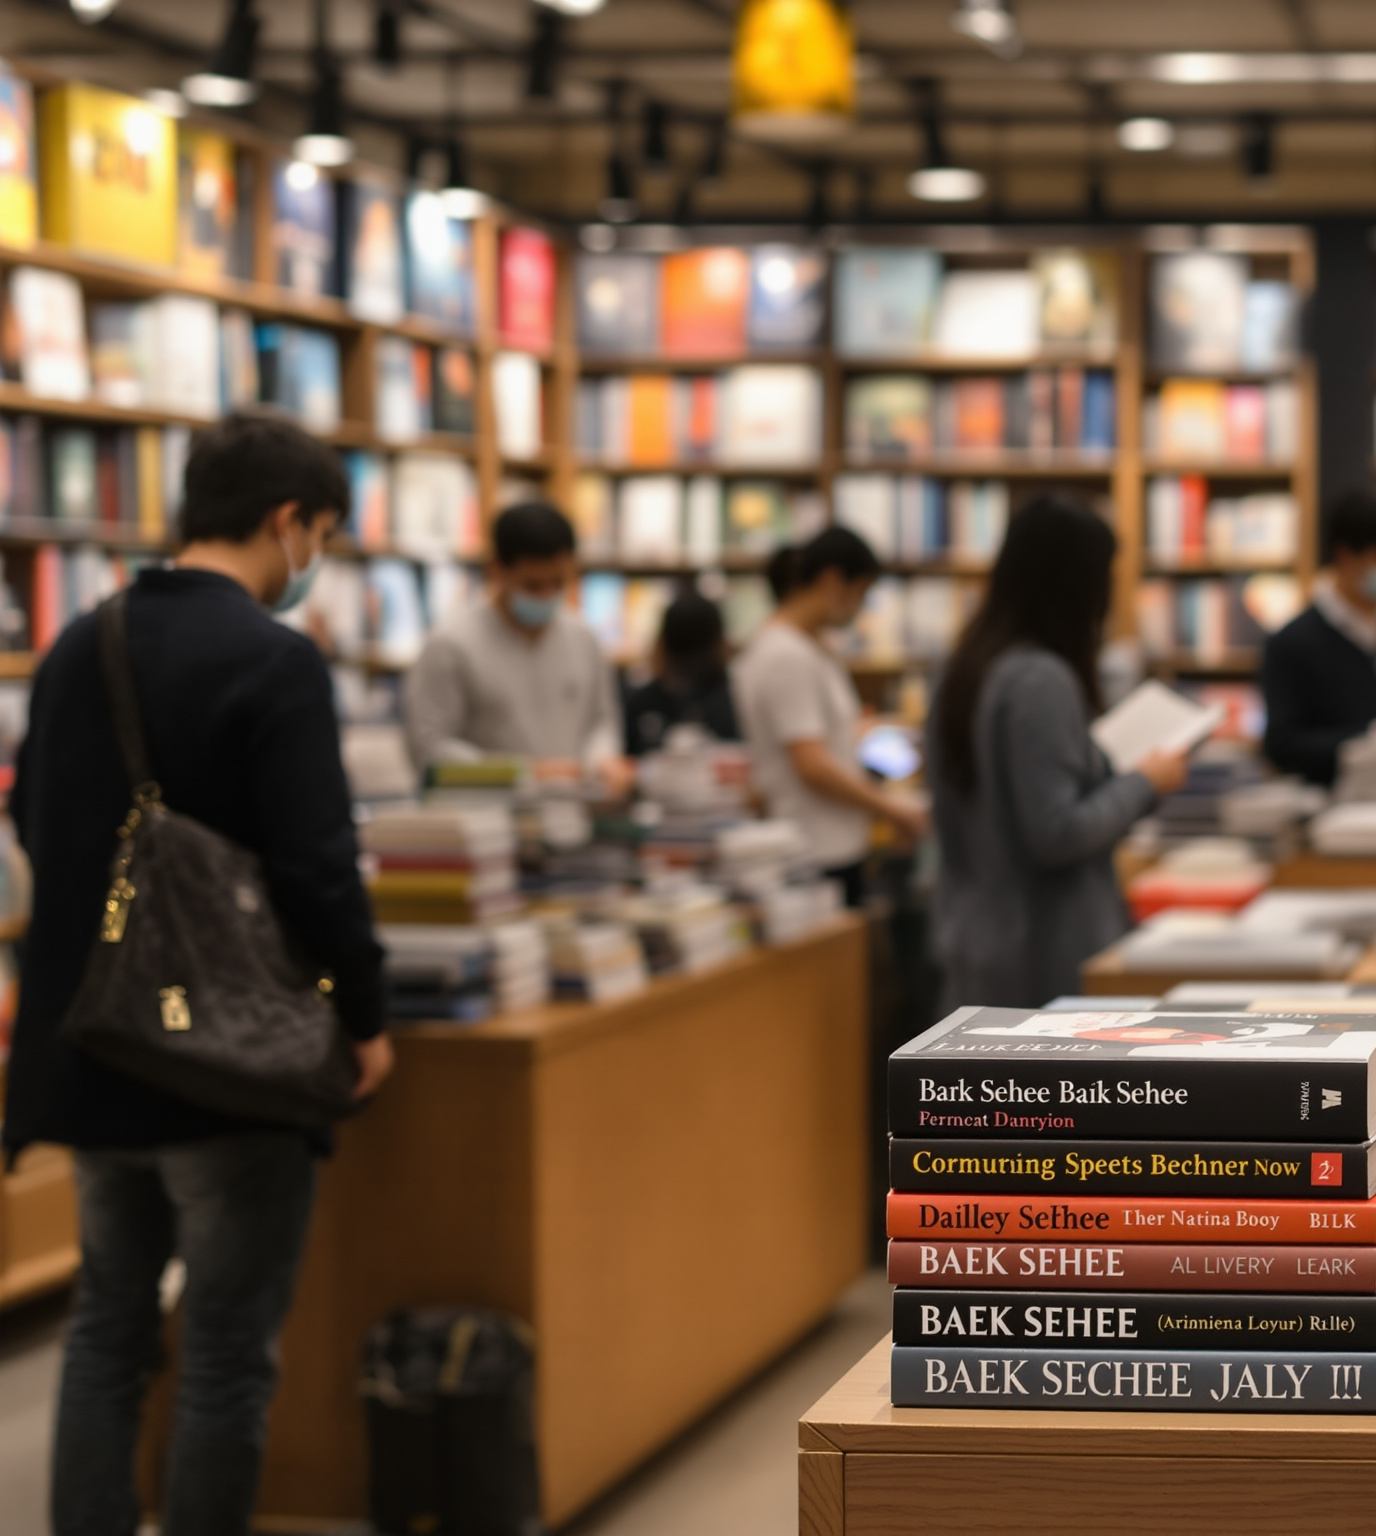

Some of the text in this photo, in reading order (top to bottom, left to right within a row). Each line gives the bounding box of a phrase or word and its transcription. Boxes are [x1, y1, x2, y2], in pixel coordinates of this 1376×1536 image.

[919, 1078, 974, 1102] Bark
[980, 1079, 1050, 1103] Sehee
[1117, 1080, 1188, 1105] Sehee
[1065, 1152, 1143, 1181] Speets
[1151, 1154, 1248, 1176] Bechner
[920, 1246, 1124, 1277] BAEK SEHEE
[1170, 1256, 1356, 1275] AL LIVERY LEARK
[920, 1305, 1138, 1338] BAEK SEHEE
[924, 1358, 1030, 1395] BAEK
[1042, 1359, 1192, 1397] SECHEE
[1209, 1363, 1313, 1402] JALY
